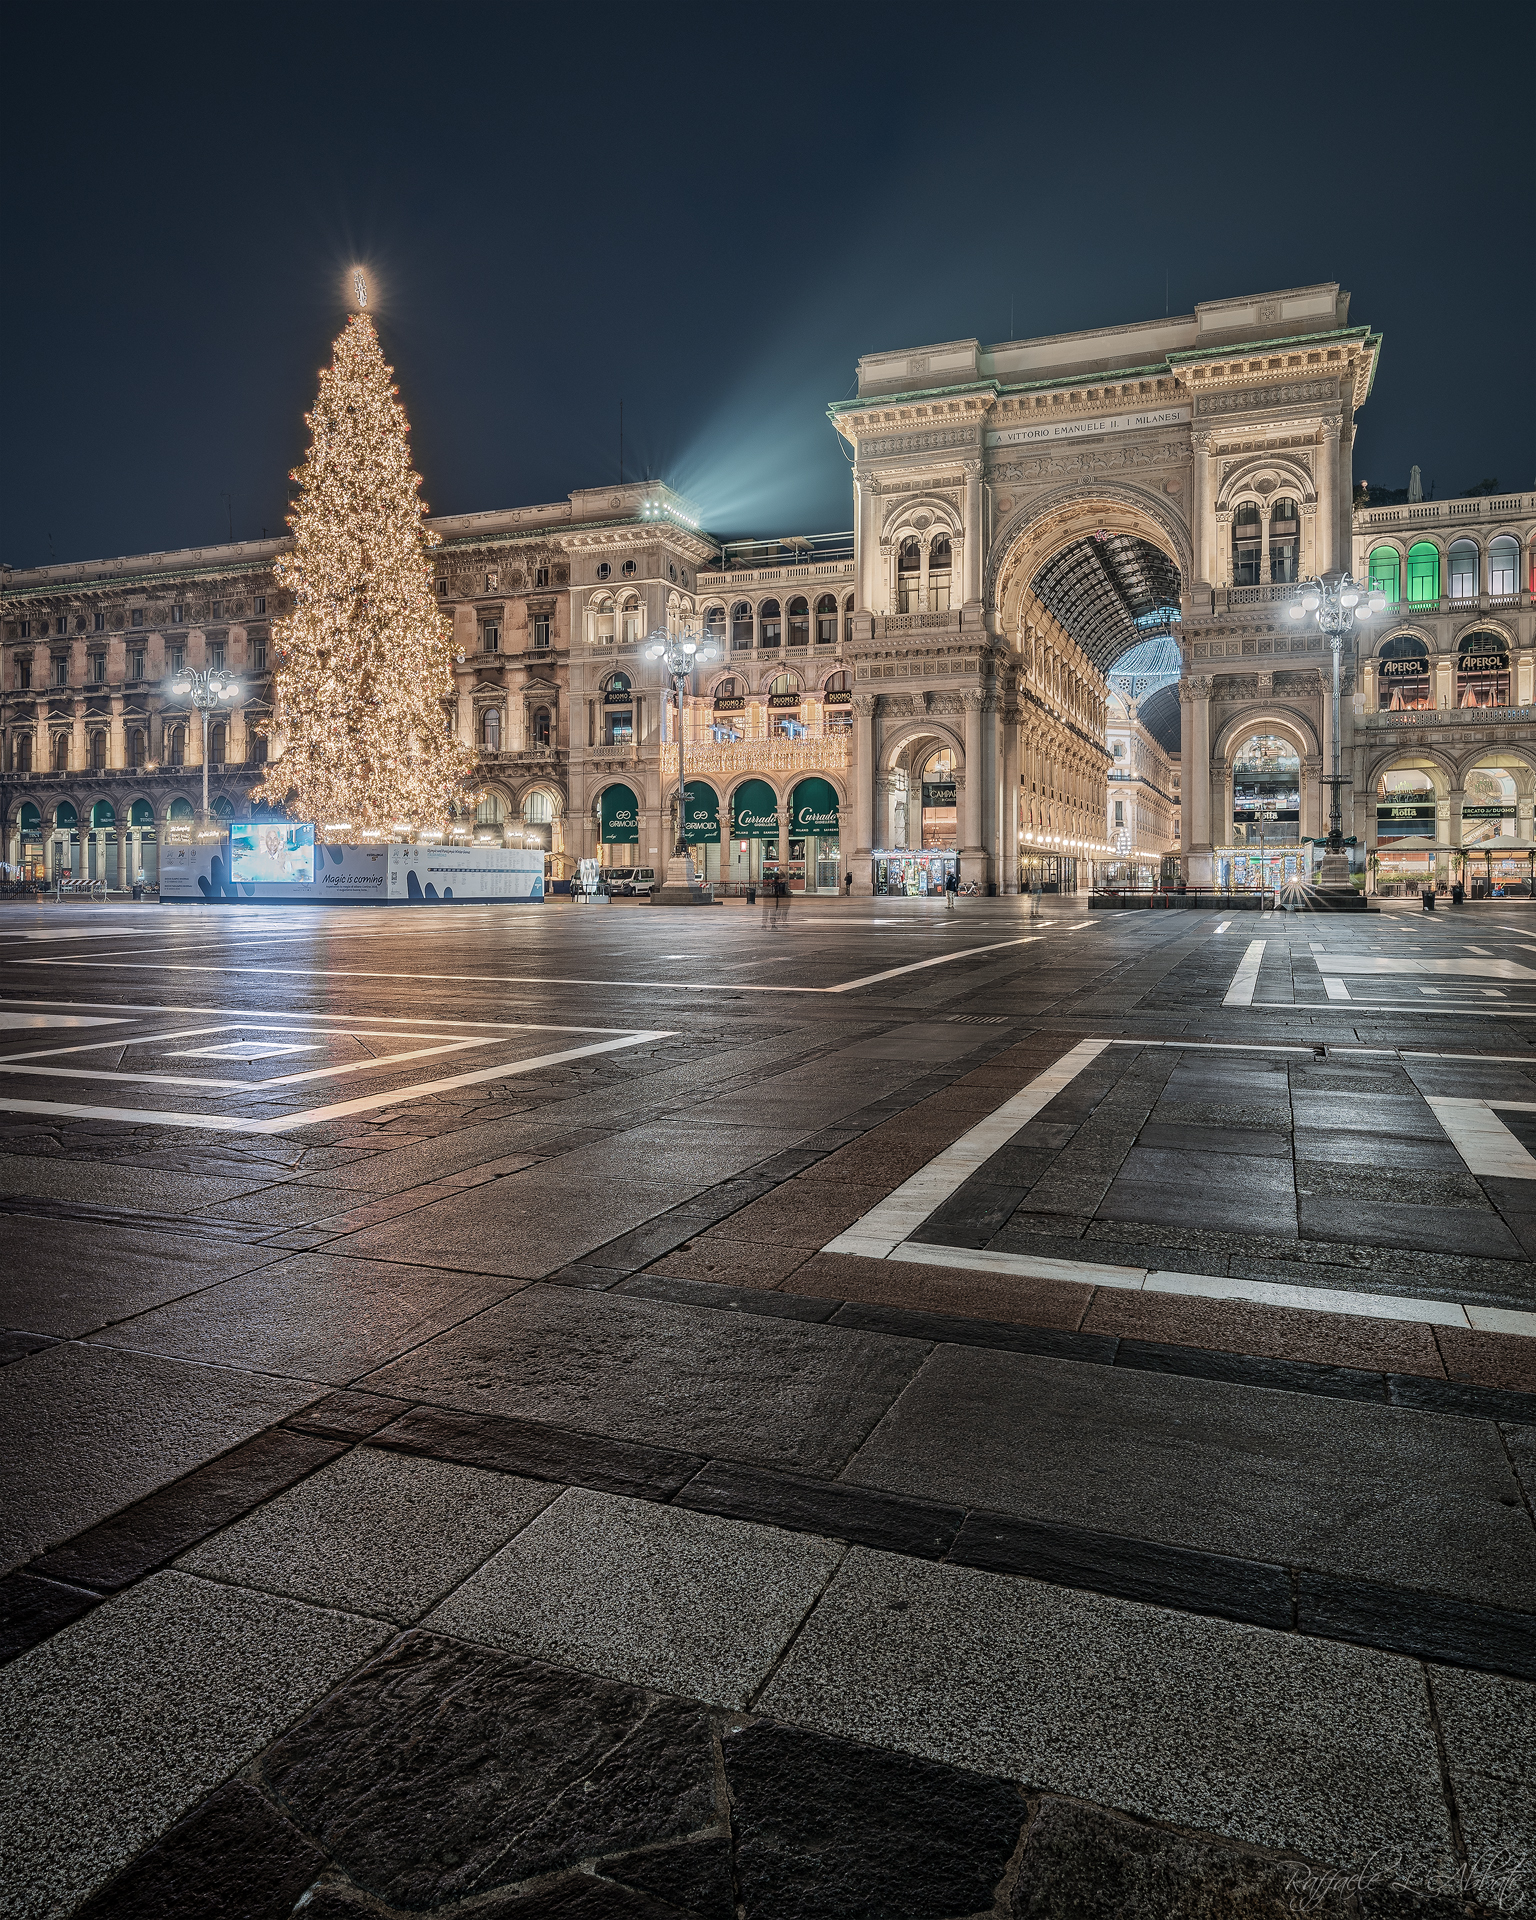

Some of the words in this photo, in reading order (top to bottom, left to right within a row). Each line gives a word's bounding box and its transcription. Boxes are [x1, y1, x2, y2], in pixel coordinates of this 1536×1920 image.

[996, 435, 1003, 443] A
[1007, 429, 1050, 441] VITTORIO
[1054, 421, 1106, 435] EMANUELE
[1135, 412, 1181, 425] MILANESI
[1384, 661, 1423, 673] APEROL
[1462, 656, 1503, 668] APEROL
[773, 696, 794, 704] DUOMO
[829, 692, 851, 700] DUOMO
[738, 809, 776, 827] Currado
[798, 807, 836, 825] Currado
[1390, 807, 1417, 817] Motta
[322, 874, 346, 885] Magic
[347, 874, 353, 883] is
[354, 874, 383, 886] coming
